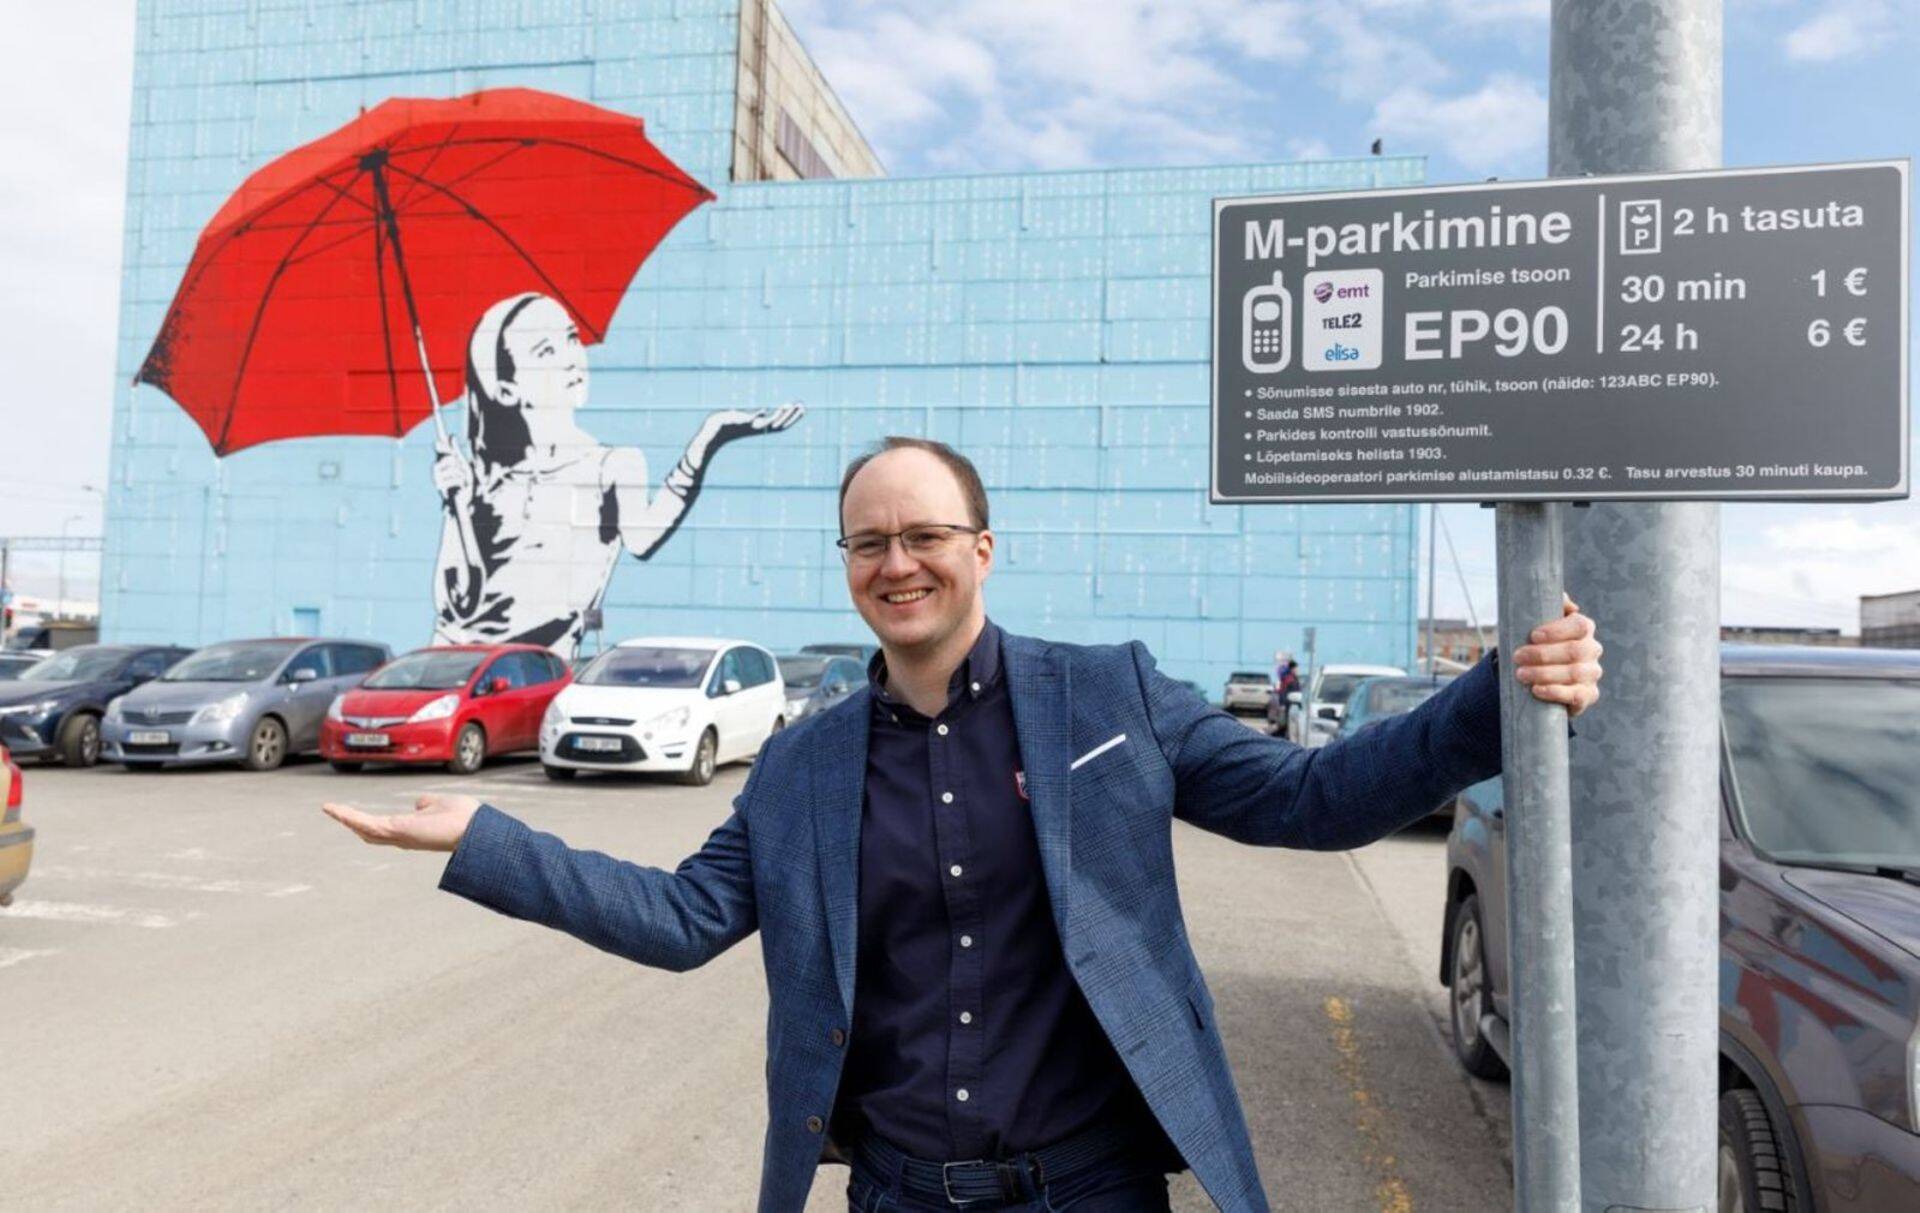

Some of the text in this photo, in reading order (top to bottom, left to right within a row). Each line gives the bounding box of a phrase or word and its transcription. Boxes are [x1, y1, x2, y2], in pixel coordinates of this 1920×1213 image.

[1673, 201, 1864, 235] 2 h tasuta
[1245, 206, 1571, 267] M-parkimine
[1635, 228, 1649, 246] P
[1406, 268, 1570, 288] Parkimise tsoon
[1621, 267, 1868, 303] 30 min 1 €
[1337, 285, 1369, 298] emt
[1322, 312, 1362, 329] TELE2
[1405, 306, 1568, 360] EP90
[1620, 317, 1868, 351] 24 h 6 €
[1325, 343, 1359, 361] elisa
[1257, 373, 1719, 399] Sõnumisse sisesta auto nr, tühik, tsoon (näide: 123ABC EP90).
[1257, 404, 1444, 420] Saada SMS numbrile 1902.
[1257, 425, 1492, 441] Parkides kontrolli vastussõnumit.
[1257, 448, 1446, 464] Lõpetamiseks helista 1903.
[1245, 463, 1868, 485] Mobiilsideoperaatori parkimise alustamistasu 0.32 €. Tasu arvestus 30 minuti kaupa.
